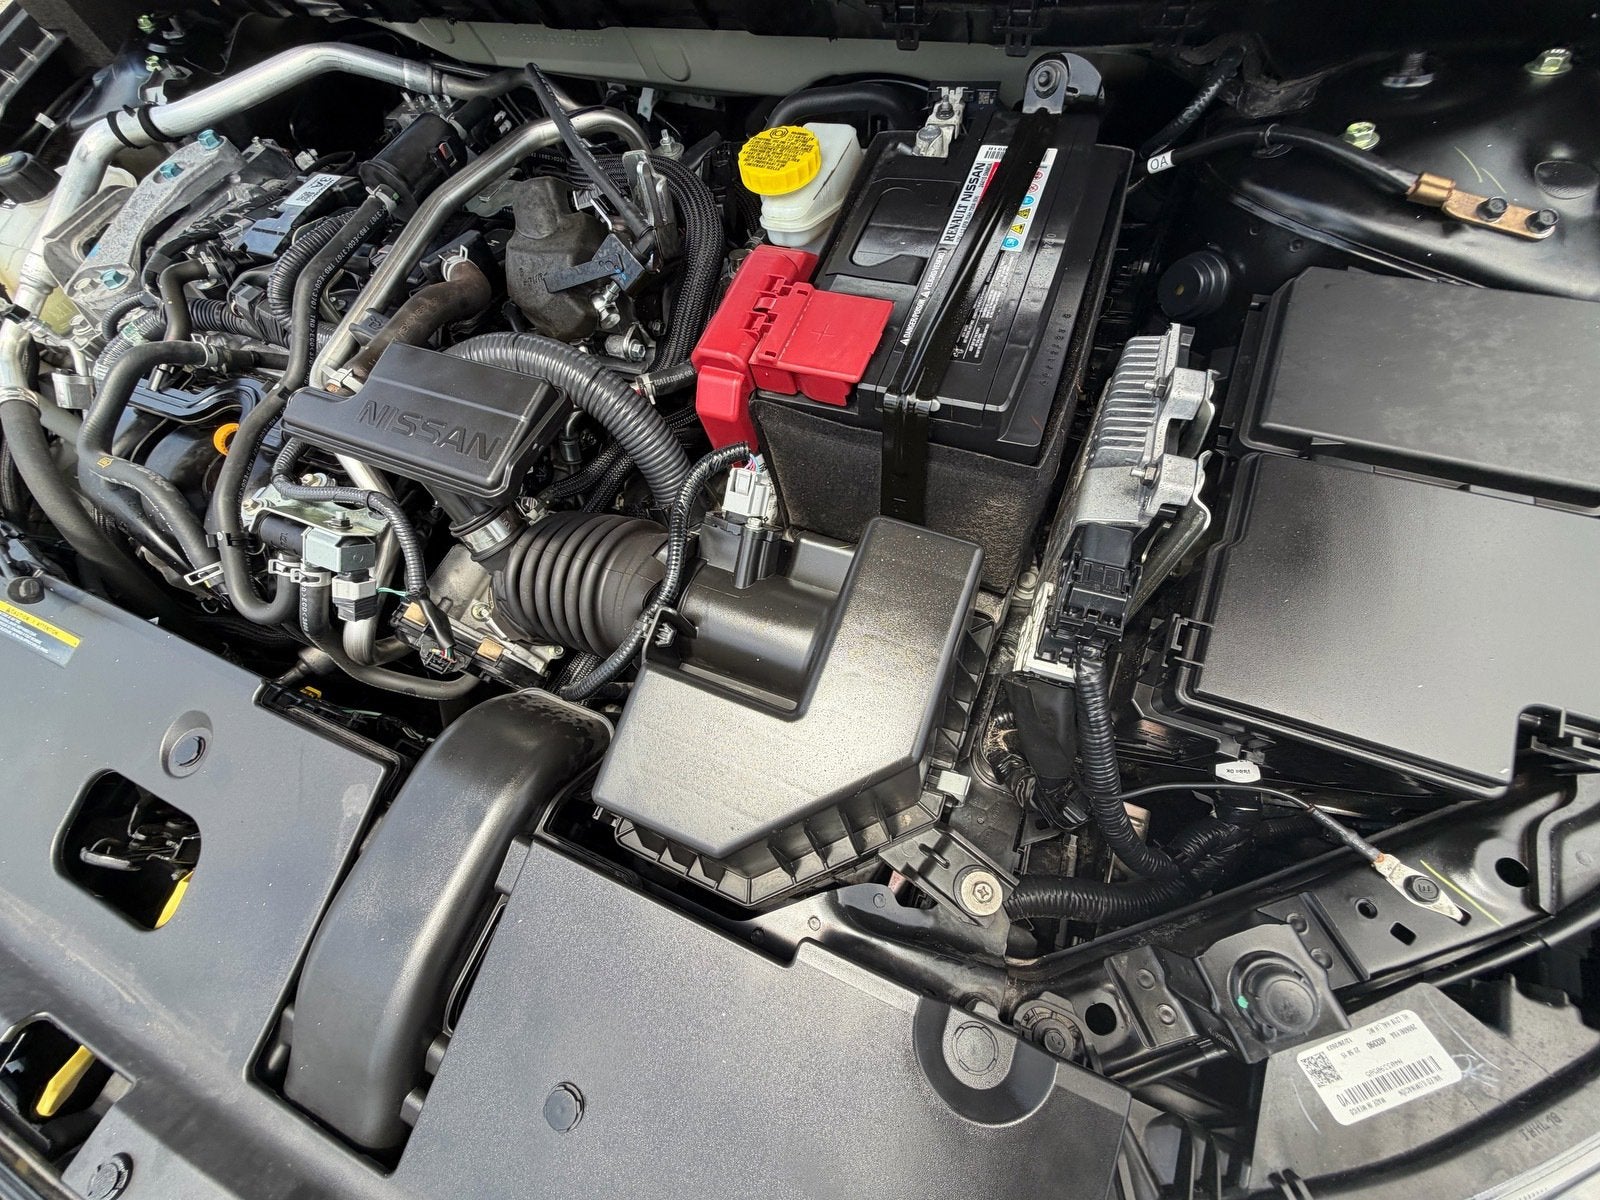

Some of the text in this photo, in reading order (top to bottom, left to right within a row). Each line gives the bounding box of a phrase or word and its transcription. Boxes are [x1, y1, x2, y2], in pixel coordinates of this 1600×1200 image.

[943, 162, 986, 242] RENAULT NISSAN
[904, 251, 945, 339] DANGER/POISON PELIGRO/VENENO
[355, 399, 501, 463] NISSAN
